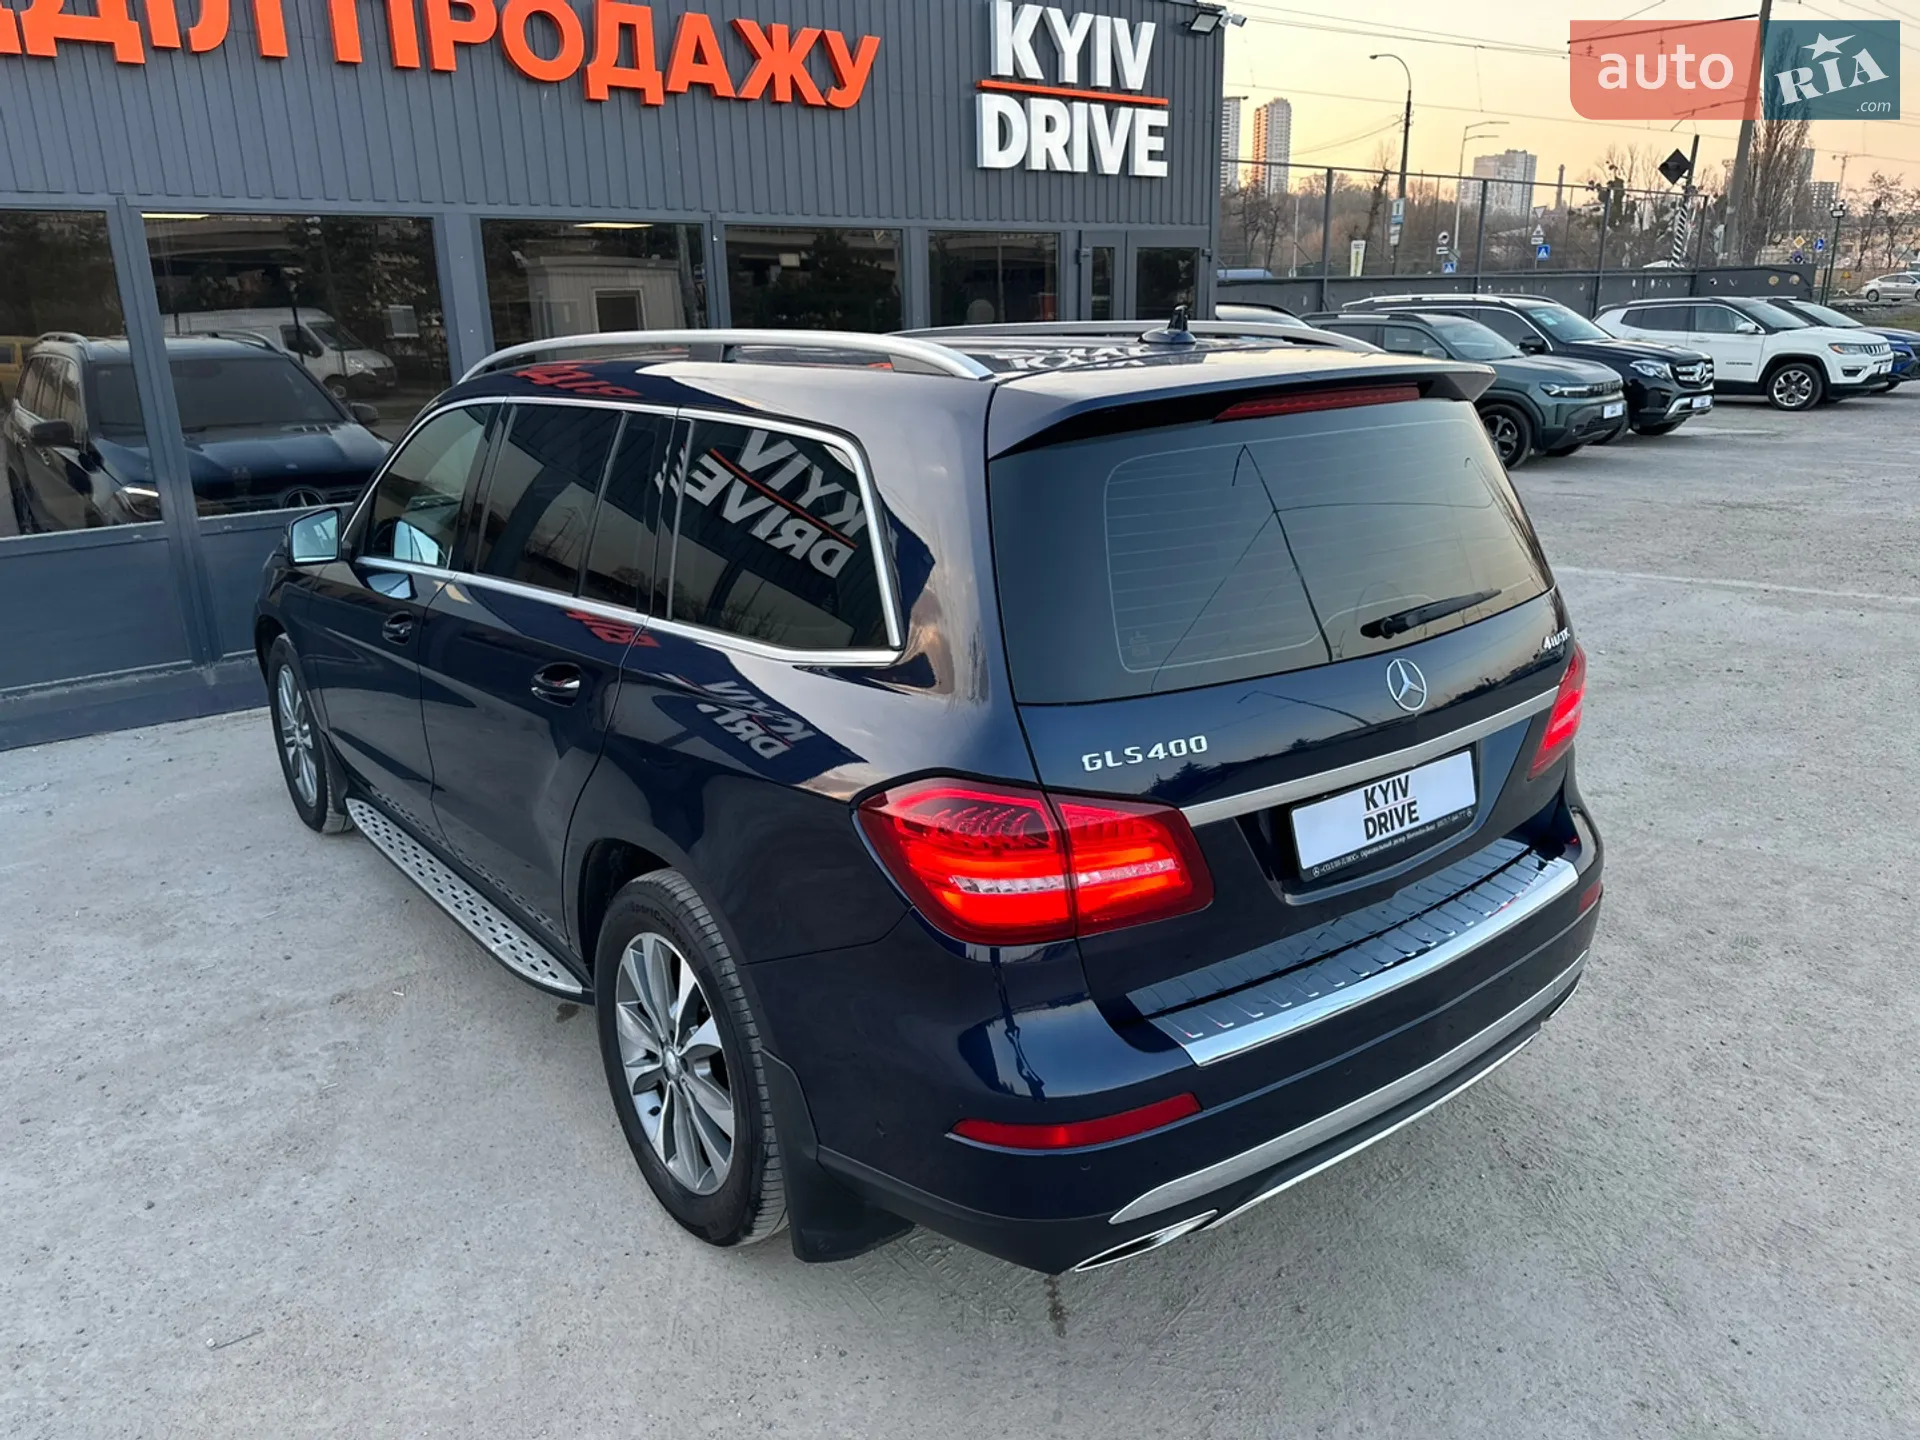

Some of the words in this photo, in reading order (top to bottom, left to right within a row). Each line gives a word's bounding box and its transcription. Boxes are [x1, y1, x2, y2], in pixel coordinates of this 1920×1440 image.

[324, 0, 881, 109] ПРОДАЖУ
[989, 0, 1157, 91] KYIV
[975, 93, 1170, 177] DRIVE
[1363, 800, 1420, 841] DRIVE
[1364, 775, 1410, 812] KYIV
